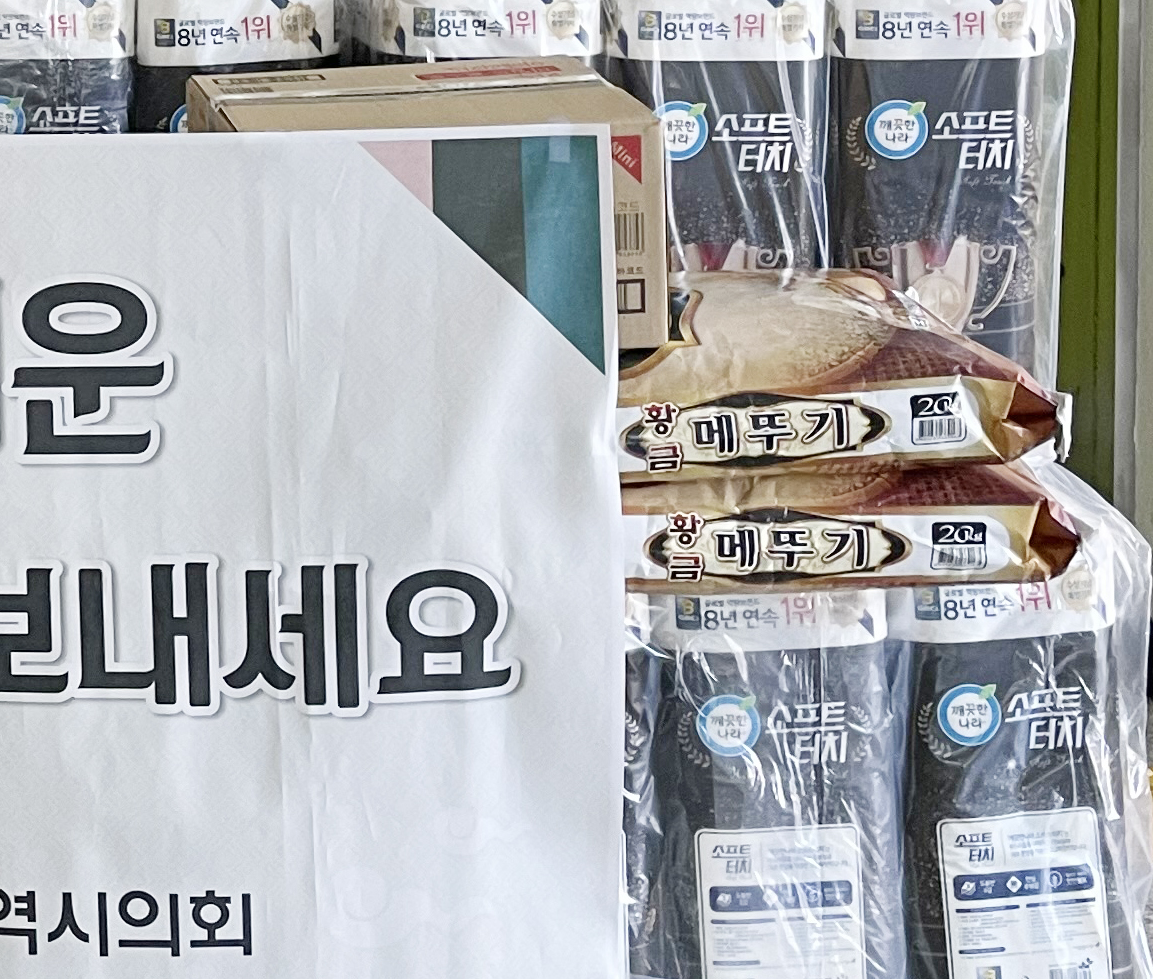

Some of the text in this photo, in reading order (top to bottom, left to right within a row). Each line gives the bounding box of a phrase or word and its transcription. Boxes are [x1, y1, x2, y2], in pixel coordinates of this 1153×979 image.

[15, 23, 46, 40] 연속
[178, 27, 206, 47] 8년
[211, 26, 241, 45] 연속
[241, 15, 271, 41] 1위
[437, 10, 537, 37] 8년 연속 1위
[663, 22, 694, 41] 8년
[698, 22, 731, 41] 연속
[734, 13, 765, 38] 1위
[882, 11, 985, 40] 8년 연속 1위
[711, 113, 792, 142] 소프트
[879, 118, 916, 131] 깨끗한
[885, 132, 909, 143] 나라
[932, 110, 1014, 140] 소프트
[737, 142, 794, 173] 터치
[959, 140, 1014, 171] 터치
[917, 396, 962, 416] 20
[689, 406, 852, 456] 메뚜기
[714, 529, 871, 572] 메뚜기
[703, 610, 737, 631] 8년
[742, 608, 780, 629] 연속
[943, 598, 976, 620] 8년
[951, 703, 988, 717] 깨끗한
[1005, 687, 1082, 722] 소프트
[958, 718, 982, 729] 나라
[1029, 717, 1083, 749] 터치
[711, 844, 751, 858] 소프트
[954, 832, 993, 847] 소프트
[968, 847, 995, 862] 터치
